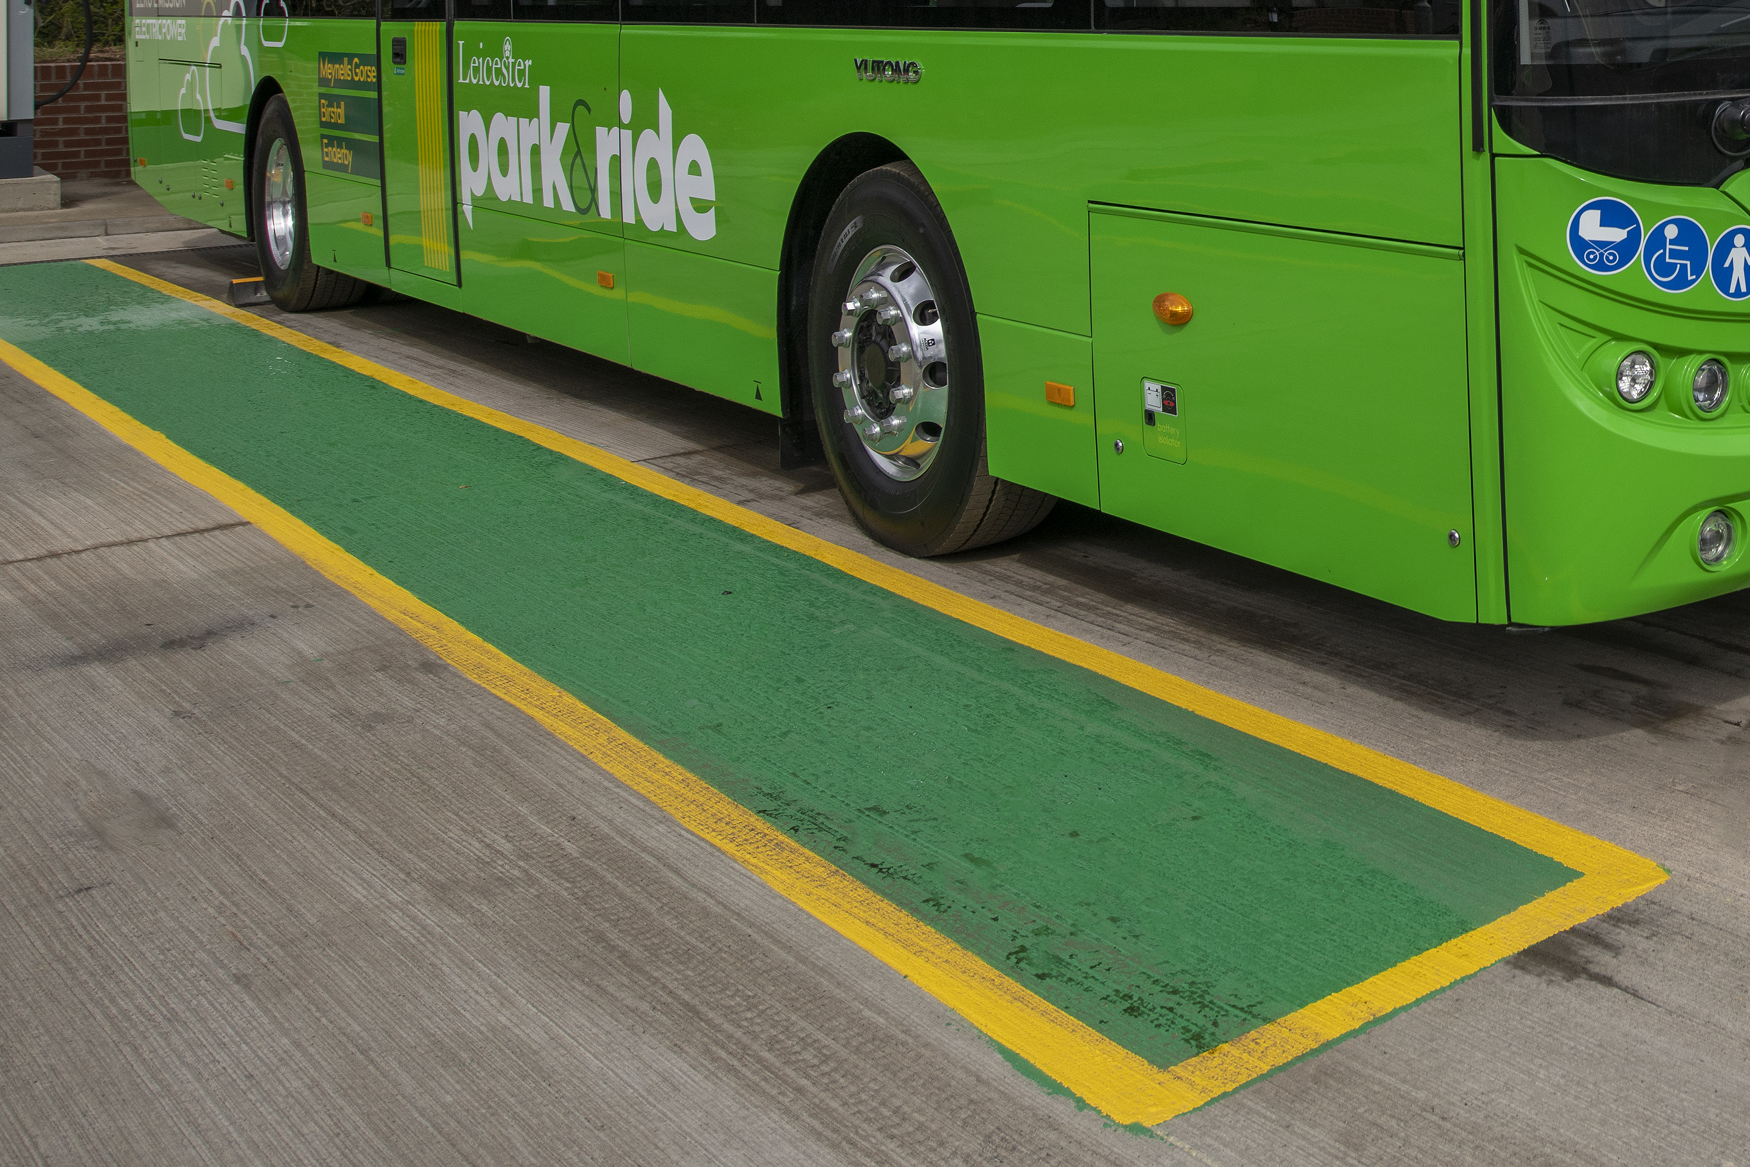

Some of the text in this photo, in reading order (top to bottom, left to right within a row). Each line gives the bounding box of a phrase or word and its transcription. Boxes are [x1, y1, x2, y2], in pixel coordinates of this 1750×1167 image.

[135, 19, 187, 41] ELECTRIC POWER
[319, 56, 377, 87] Meynells Gorse
[458, 37, 533, 88] Leicester
[854, 58, 923, 83] YUTONG
[320, 99, 345, 124] Birstall
[322, 138, 353, 173] Enderby
[1157, 421, 1180, 439] battery
[1158, 434, 1181, 448] isolator
